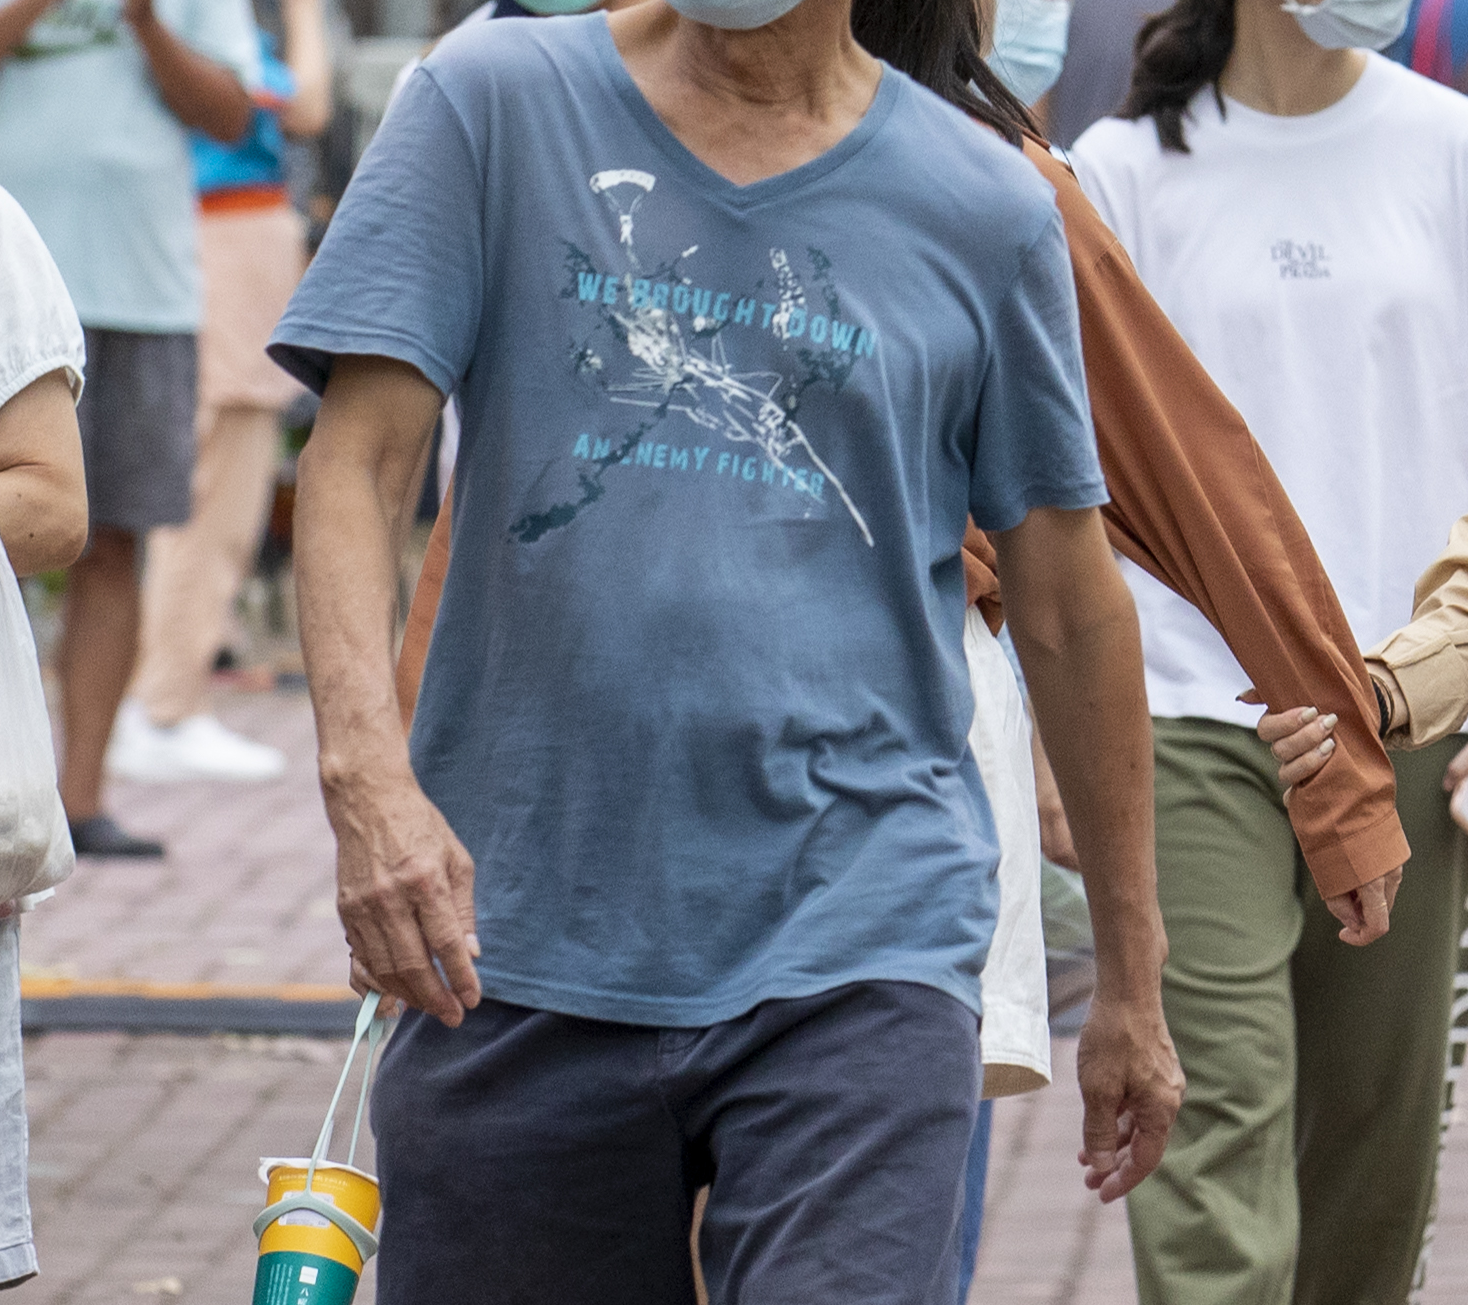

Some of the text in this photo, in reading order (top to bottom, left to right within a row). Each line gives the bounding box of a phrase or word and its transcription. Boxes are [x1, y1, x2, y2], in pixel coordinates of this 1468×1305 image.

[577, 271, 879, 360] WE BROUGHT DOWN
[572, 433, 826, 497] AN NEMY FIGHTER
